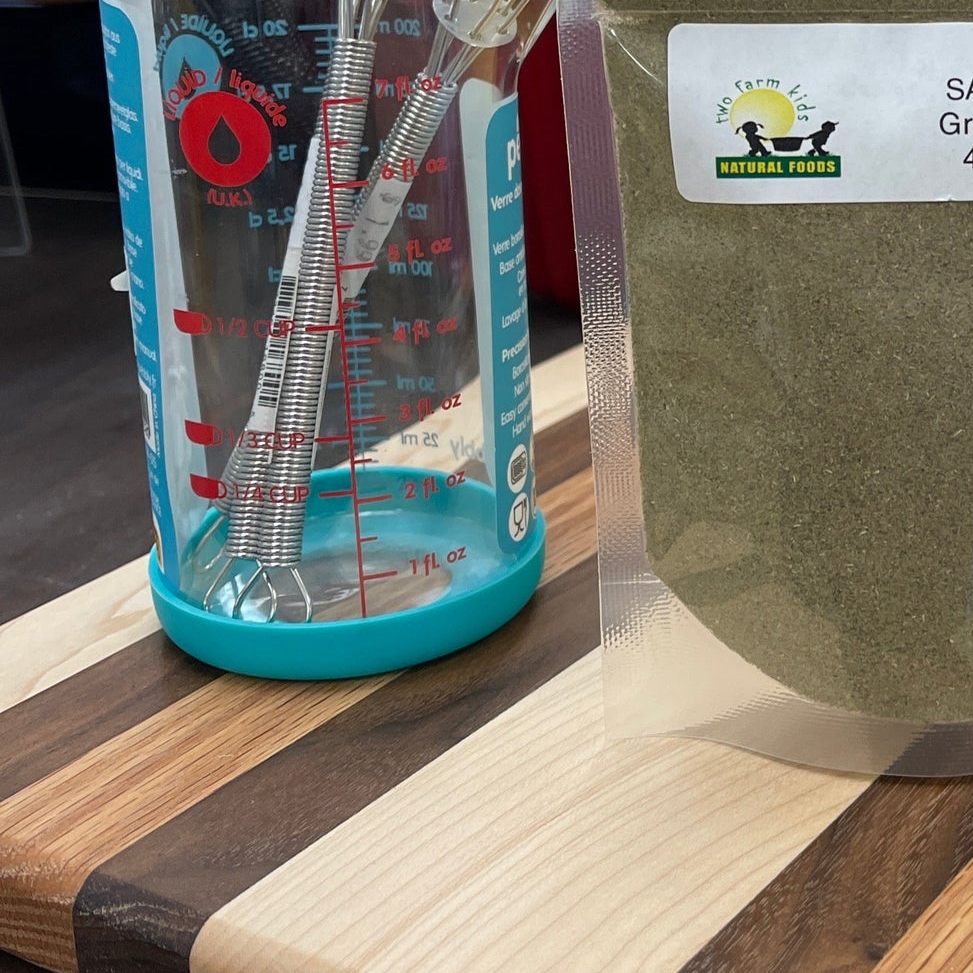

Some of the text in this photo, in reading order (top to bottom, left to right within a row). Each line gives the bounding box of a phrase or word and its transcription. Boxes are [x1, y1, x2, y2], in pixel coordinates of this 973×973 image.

[421, 76, 442, 92] oz
[228, 69, 287, 127] liquide
[716, 96, 732, 124] two
[788, 84, 816, 122] kids
[381, 162, 394, 180] 6
[425, 157, 447, 174] oz
[720, 160, 836, 174] NATURAL FOODS
[207, 188, 253, 208] (U.K.)
[387, 244, 400, 263] 5
[431, 237, 452, 255] oz
[253, 320, 296, 339] CUP
[399, 403, 412, 421] 3
[441, 393, 462, 410] oz
[264, 432, 305, 450] CUP
[269, 486, 310, 503] CUP
[404, 482, 416, 499] 2
[446, 470, 466, 487] oz
[409, 559, 417, 575] 1
[447, 546, 467, 563] oz
